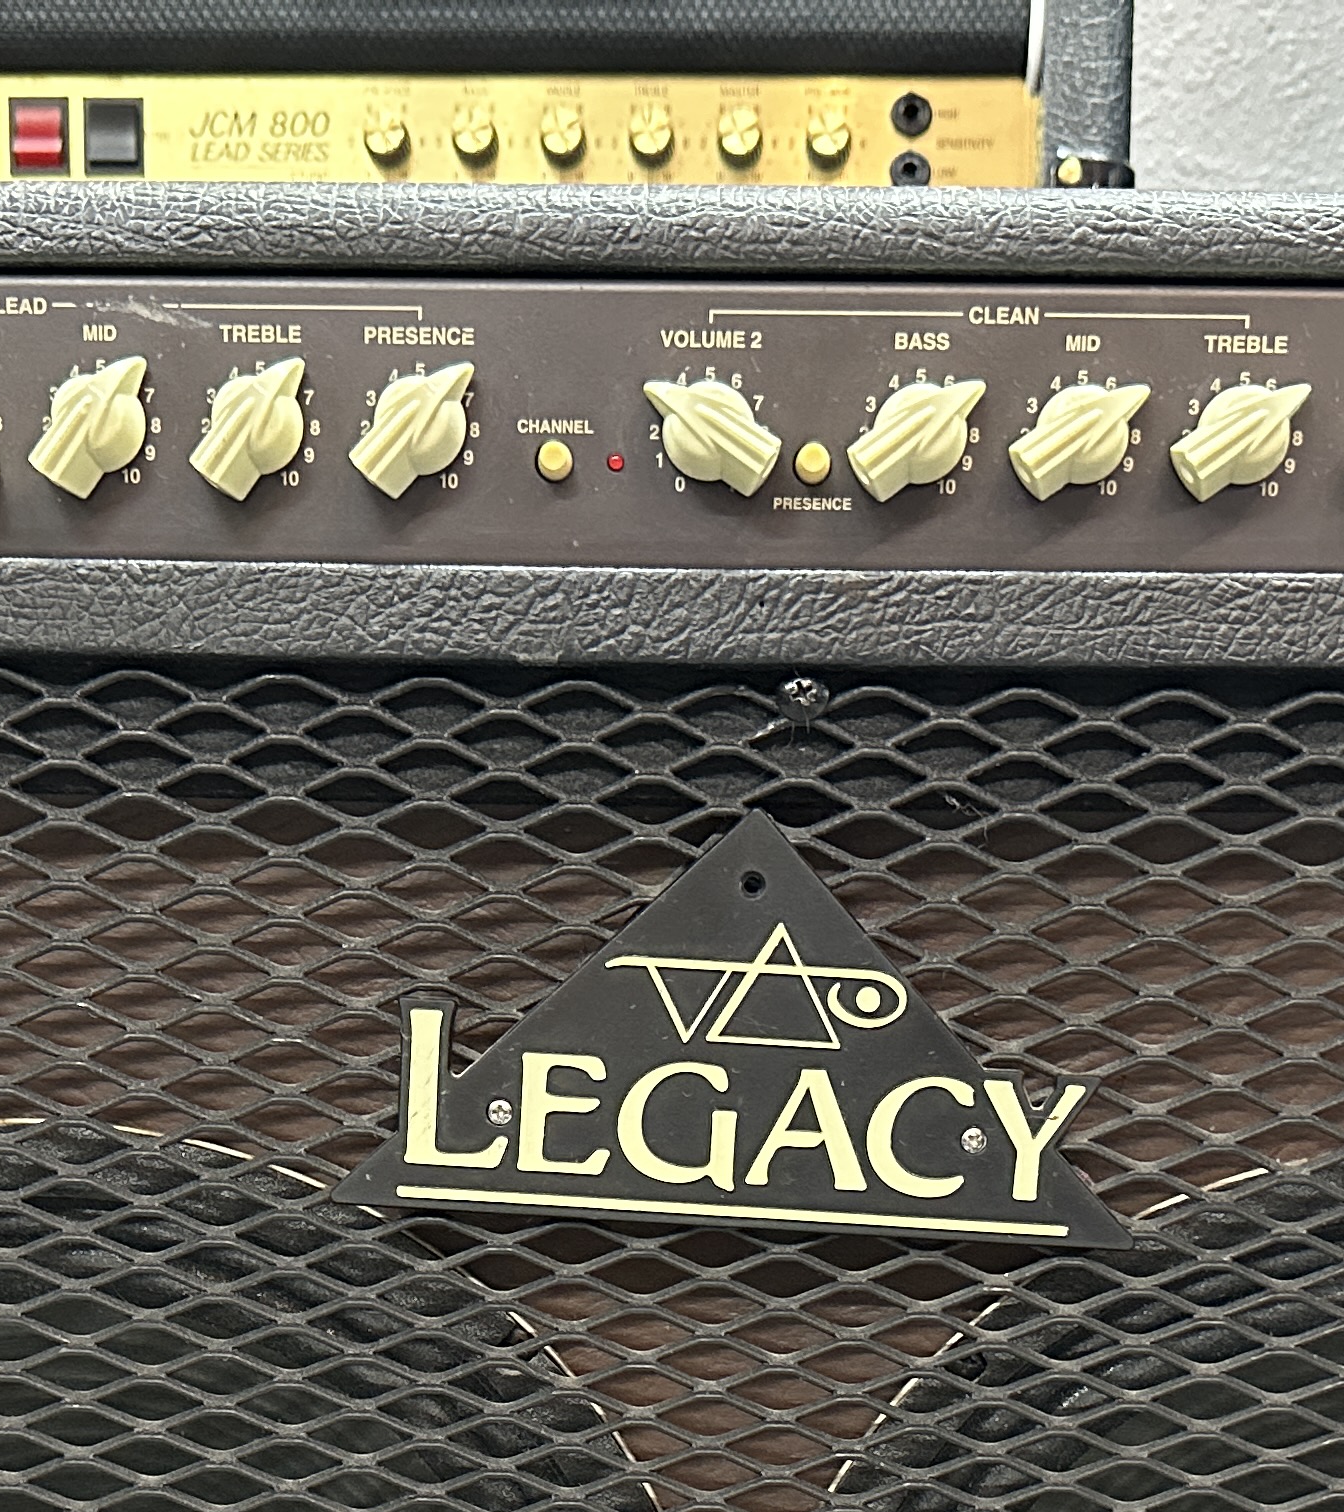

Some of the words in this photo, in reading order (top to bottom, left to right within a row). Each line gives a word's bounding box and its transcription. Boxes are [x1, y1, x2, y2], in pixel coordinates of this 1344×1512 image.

[189, 110, 257, 139] JCM
[269, 110, 331, 138] 800
[190, 141, 251, 163] LEAD
[257, 141, 329, 163] SERIES
[968, 306, 1039, 325] CLEAN
[82, 324, 117, 342] MID
[219, 324, 302, 343] TREBLE
[364, 326, 474, 346] PRESENCE
[660, 329, 745, 349] VOLUME
[751, 331, 763, 349] 2
[894, 332, 950, 351] BASS
[1066, 335, 1100, 352] MID
[1204, 335, 1289, 354] TREBLE
[69, 365, 79, 377] 4
[95, 360, 106, 374] 5
[229, 367, 238, 380] 4
[256, 361, 266, 375] 5
[415, 361, 426, 377] 5
[706, 366, 716, 381] 5
[388, 369, 398, 382] 4
[677, 372, 687, 386] 4
[731, 373, 743, 389] 6
[888, 375, 899, 391] 4
[915, 368, 927, 383] 5
[944, 375, 955, 388] 6
[1050, 376, 1061, 391] 4
[1077, 370, 1088, 385] 5
[1240, 372, 1250, 386] 5
[1106, 377, 1117, 391] 6
[1210, 378, 1221, 393] 4
[1266, 378, 1277, 391] 6
[144, 388, 154, 404] 7
[207, 388, 216, 404] 3
[304, 389, 314, 405] 7
[366, 390, 376, 407] 3
[464, 392, 474, 408] 7
[753, 395, 764, 411] 7
[865, 396, 876, 413] 3
[1026, 397, 1038, 413] 3
[1188, 399, 1200, 415] 3
[42, 416, 52, 431] 2
[150, 418, 161, 433] 8
[201, 419, 211, 434] 2
[310, 420, 321, 436] 8
[360, 420, 371, 436] 2
[469, 422, 480, 438] 8
[517, 419, 594, 435] CHANNEL
[649, 424, 660, 441] 2
[969, 428, 980, 443] 8
[1130, 429, 1141, 444] 8
[1292, 430, 1303, 446] 8
[144, 445, 156, 461] 9
[304, 447, 314, 463] 9
[463, 450, 474, 466] 9
[656, 453, 663, 468] 1
[962, 455, 972, 471] 9
[1123, 457, 1134, 472] 9
[1284, 458, 1295, 474] 9
[121, 468, 141, 484] 10
[280, 471, 299, 487] 10
[440, 473, 458, 489] 10
[675, 476, 686, 493] 0
[938, 479, 956, 495] 10
[1098, 480, 1117, 496] 10
[1259, 481, 1279, 497] 10
[773, 497, 852, 511] PRESENCE
[403, 1007, 1087, 1202] LEGACY
